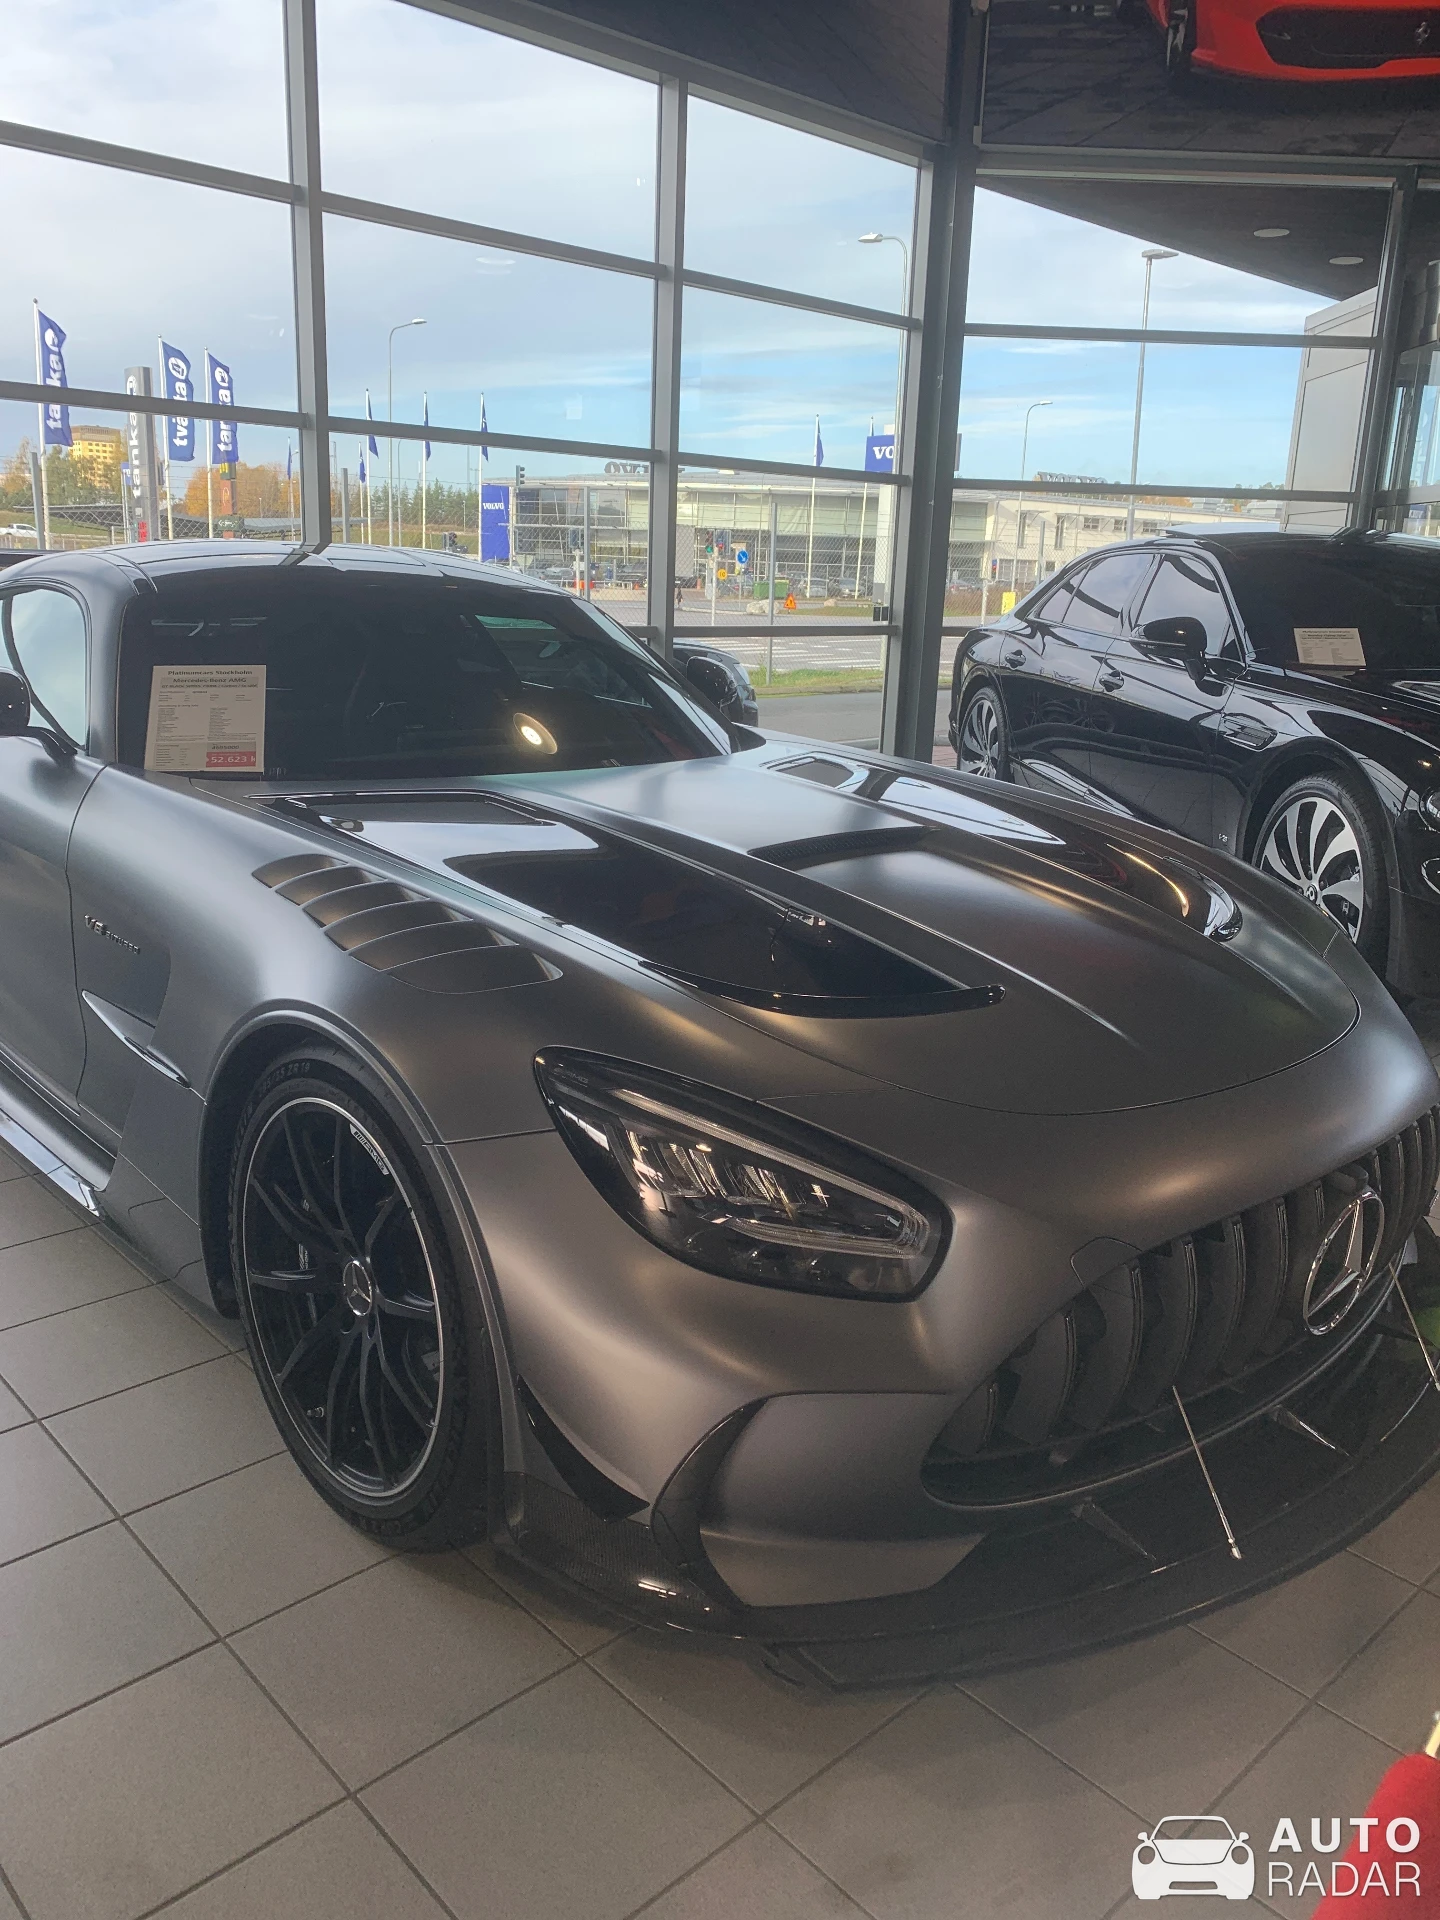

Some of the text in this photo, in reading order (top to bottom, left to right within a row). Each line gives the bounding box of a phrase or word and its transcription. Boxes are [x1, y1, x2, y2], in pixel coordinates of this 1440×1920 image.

[46, 353, 62, 429] taka
[172, 381, 188, 446] tväta
[217, 388, 232, 452] tana
[482, 502, 505, 510] VOLVO
[84, 914, 104, 936] V8
